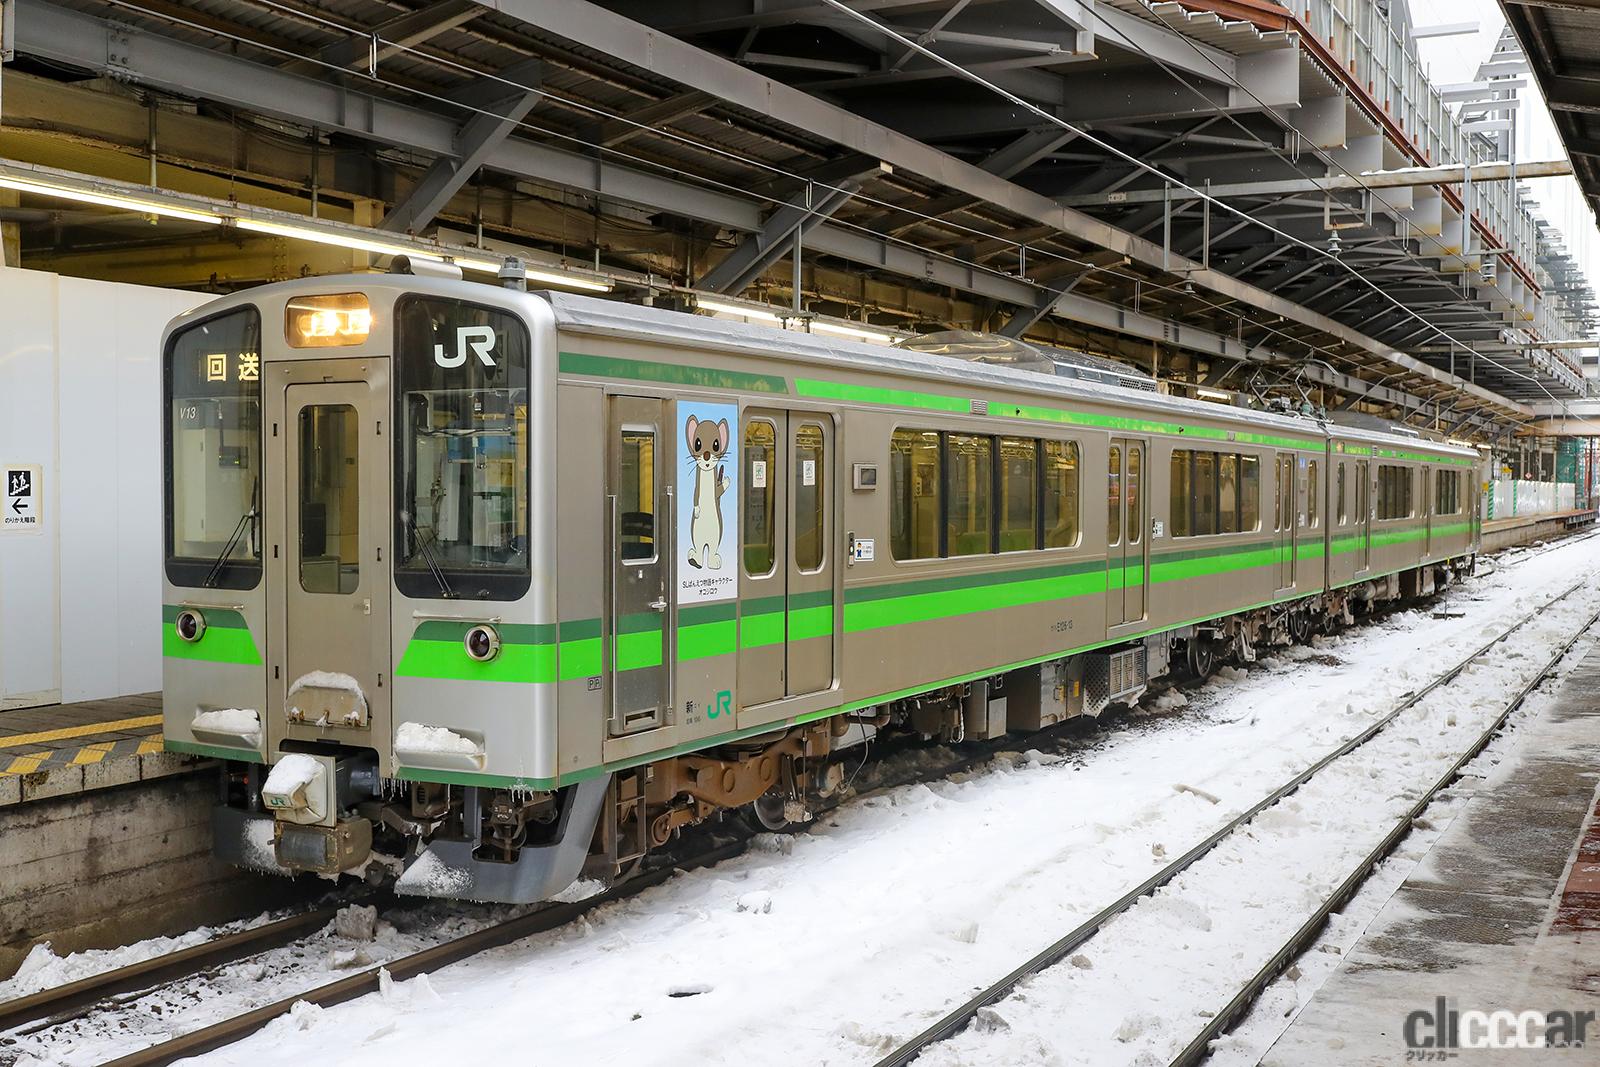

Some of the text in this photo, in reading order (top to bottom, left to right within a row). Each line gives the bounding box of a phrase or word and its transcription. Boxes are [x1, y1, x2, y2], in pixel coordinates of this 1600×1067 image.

[435, 326, 497, 368] JR
[179, 406, 197, 420] V13
[707, 690, 731, 719] JR
[271, 797, 286, 806] JR
